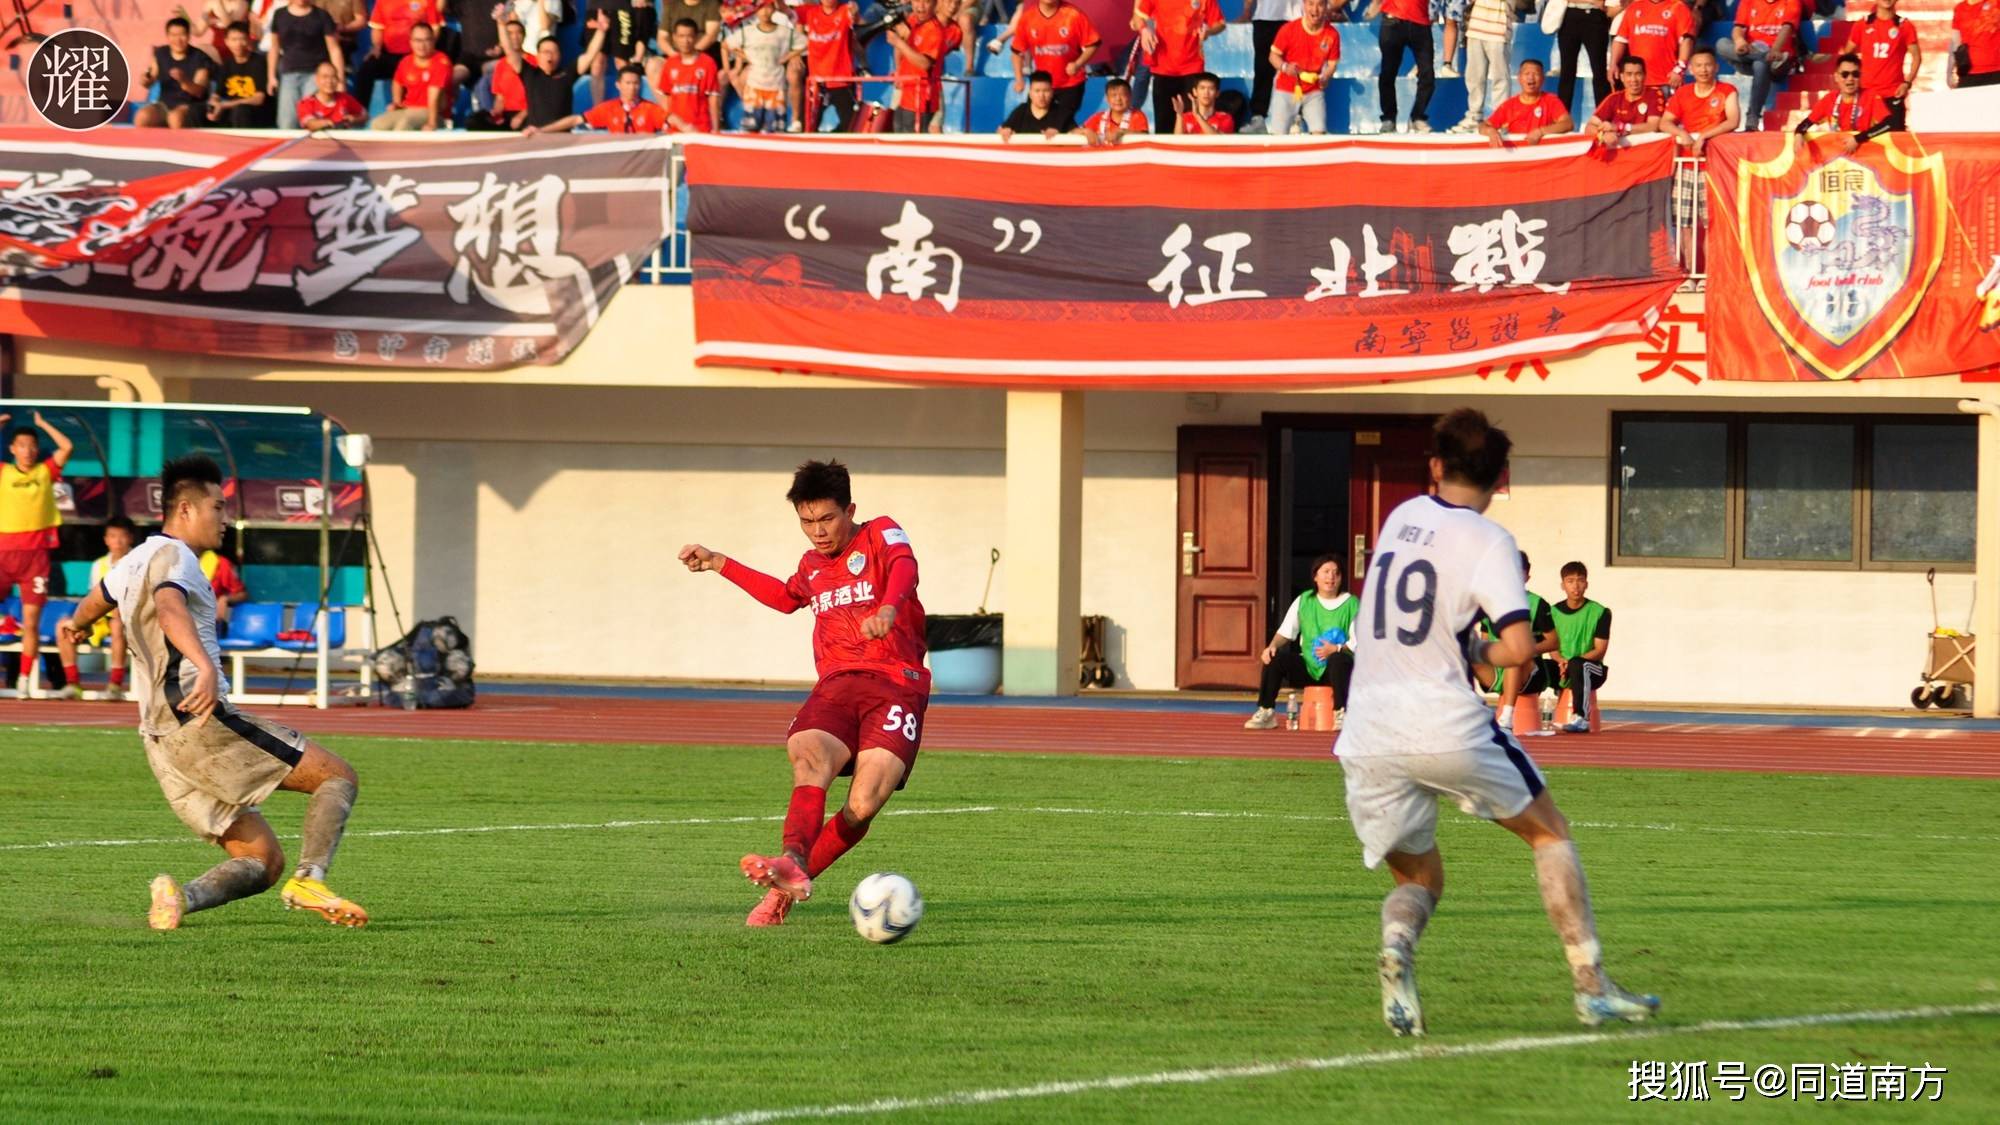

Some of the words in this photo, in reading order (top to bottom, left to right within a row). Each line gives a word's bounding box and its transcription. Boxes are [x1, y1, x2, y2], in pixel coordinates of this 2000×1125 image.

[1873, 42, 1890, 59] 12
[0, 168, 583, 314] 就梦想
[1373, 551, 1438, 647] 19
[883, 705, 917, 742] 58
